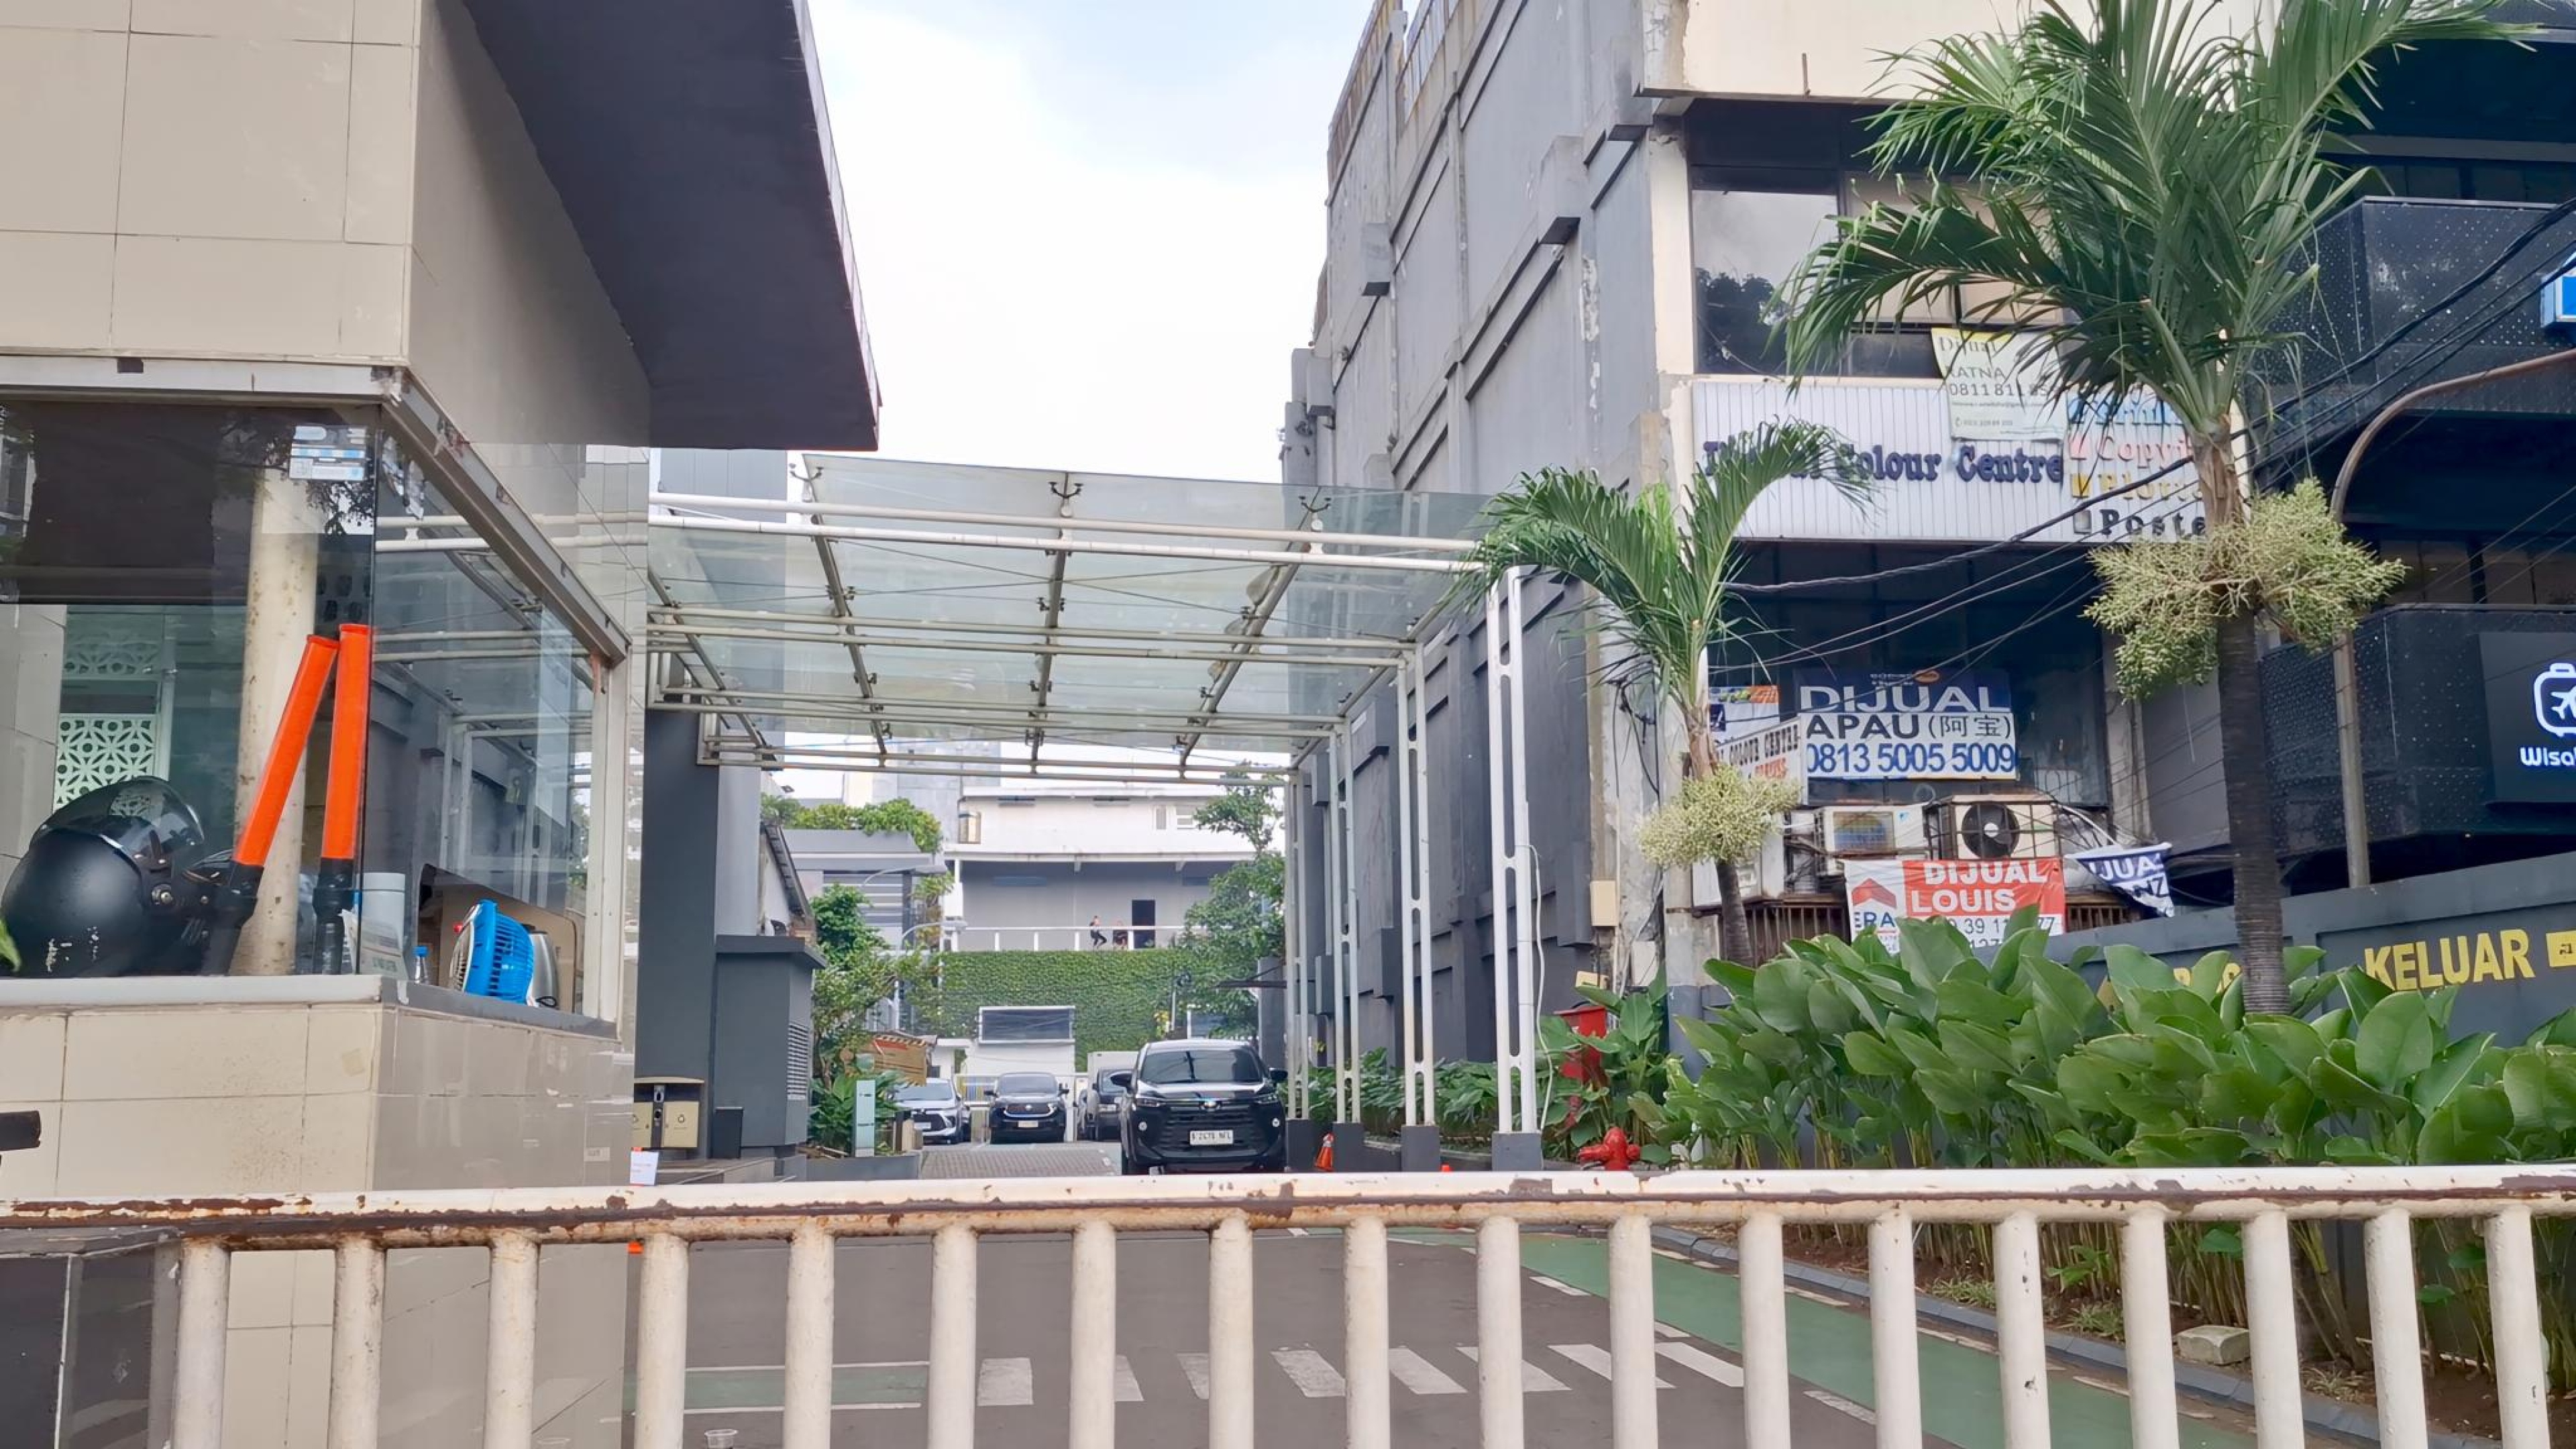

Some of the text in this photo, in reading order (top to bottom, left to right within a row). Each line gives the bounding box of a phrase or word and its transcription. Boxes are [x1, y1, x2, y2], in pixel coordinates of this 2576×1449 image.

[1949, 383, 1988, 396] 0811
[1956, 445, 2063, 483] Centre
[2099, 508, 2206, 535] Poste
[1799, 686, 2011, 713] DIJUAL
[1807, 714, 1919, 739] APAU
[1807, 743, 1870, 772] 0813
[1878, 743, 1945, 772] 5005
[1951, 743, 2015, 772] 5009
[1923, 861, 2049, 885] DIJUAL
[1912, 888, 2017, 913] LOUIS
[2364, 928, 2536, 991] KELUAR
